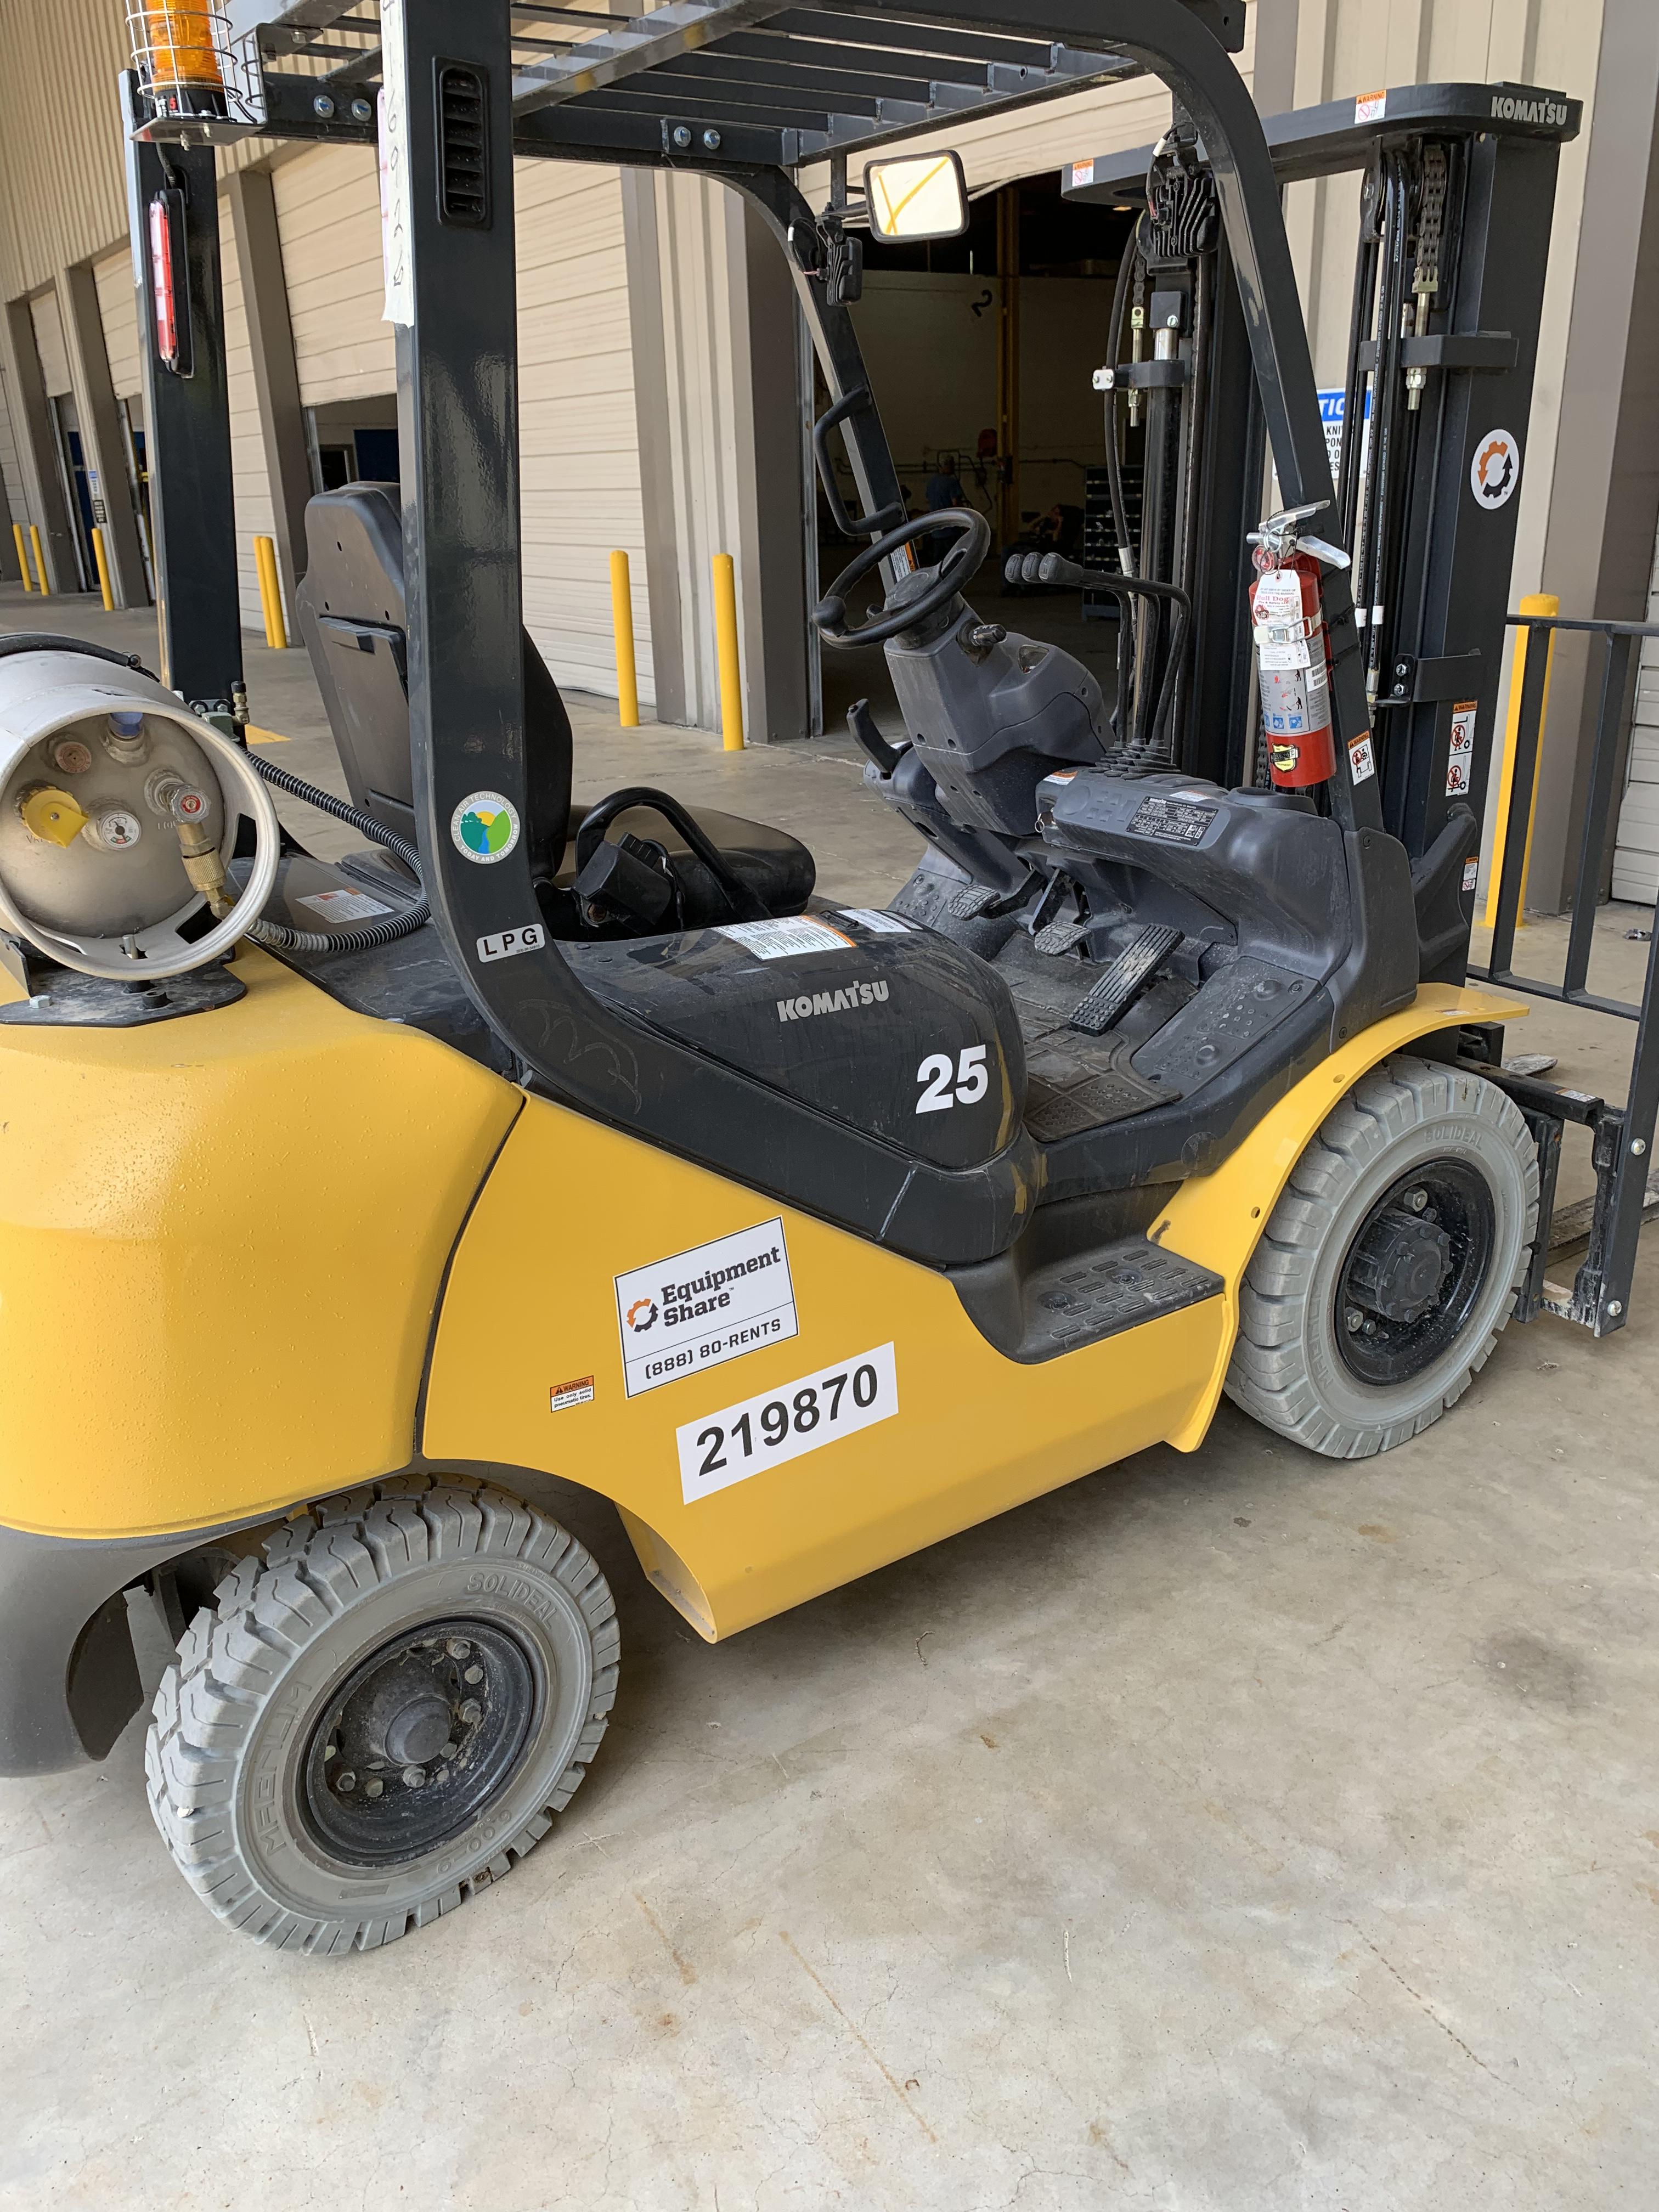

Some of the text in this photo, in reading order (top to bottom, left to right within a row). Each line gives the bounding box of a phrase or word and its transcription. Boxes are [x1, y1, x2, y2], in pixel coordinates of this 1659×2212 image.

[1491, 95, 1567, 125] KOMATSU
[1273, 596, 1289, 604] Dog
[458, 800, 470, 814] AIR
[469, 793, 517, 819] TECHNOLOGY
[460, 845, 479, 861] TODAY
[496, 824, 518, 859] TOMORROW
[776, 980, 890, 1022] KOMATSU
[916, 1044, 988, 1114] 25
[1424, 1125, 1482, 1150] SOLIDEAL
[661, 1246, 781, 1306] Equipment
[663, 1292, 730, 1327] Share
[645, 1318, 781, 1379] (888) 80-RENTS
[554, 1397, 579, 1408] pneumatic
[563, 1379, 589, 1392] WARNING
[697, 1364, 878, 1477] 219870
[467, 1572, 557, 1630] SOLIDEAL
